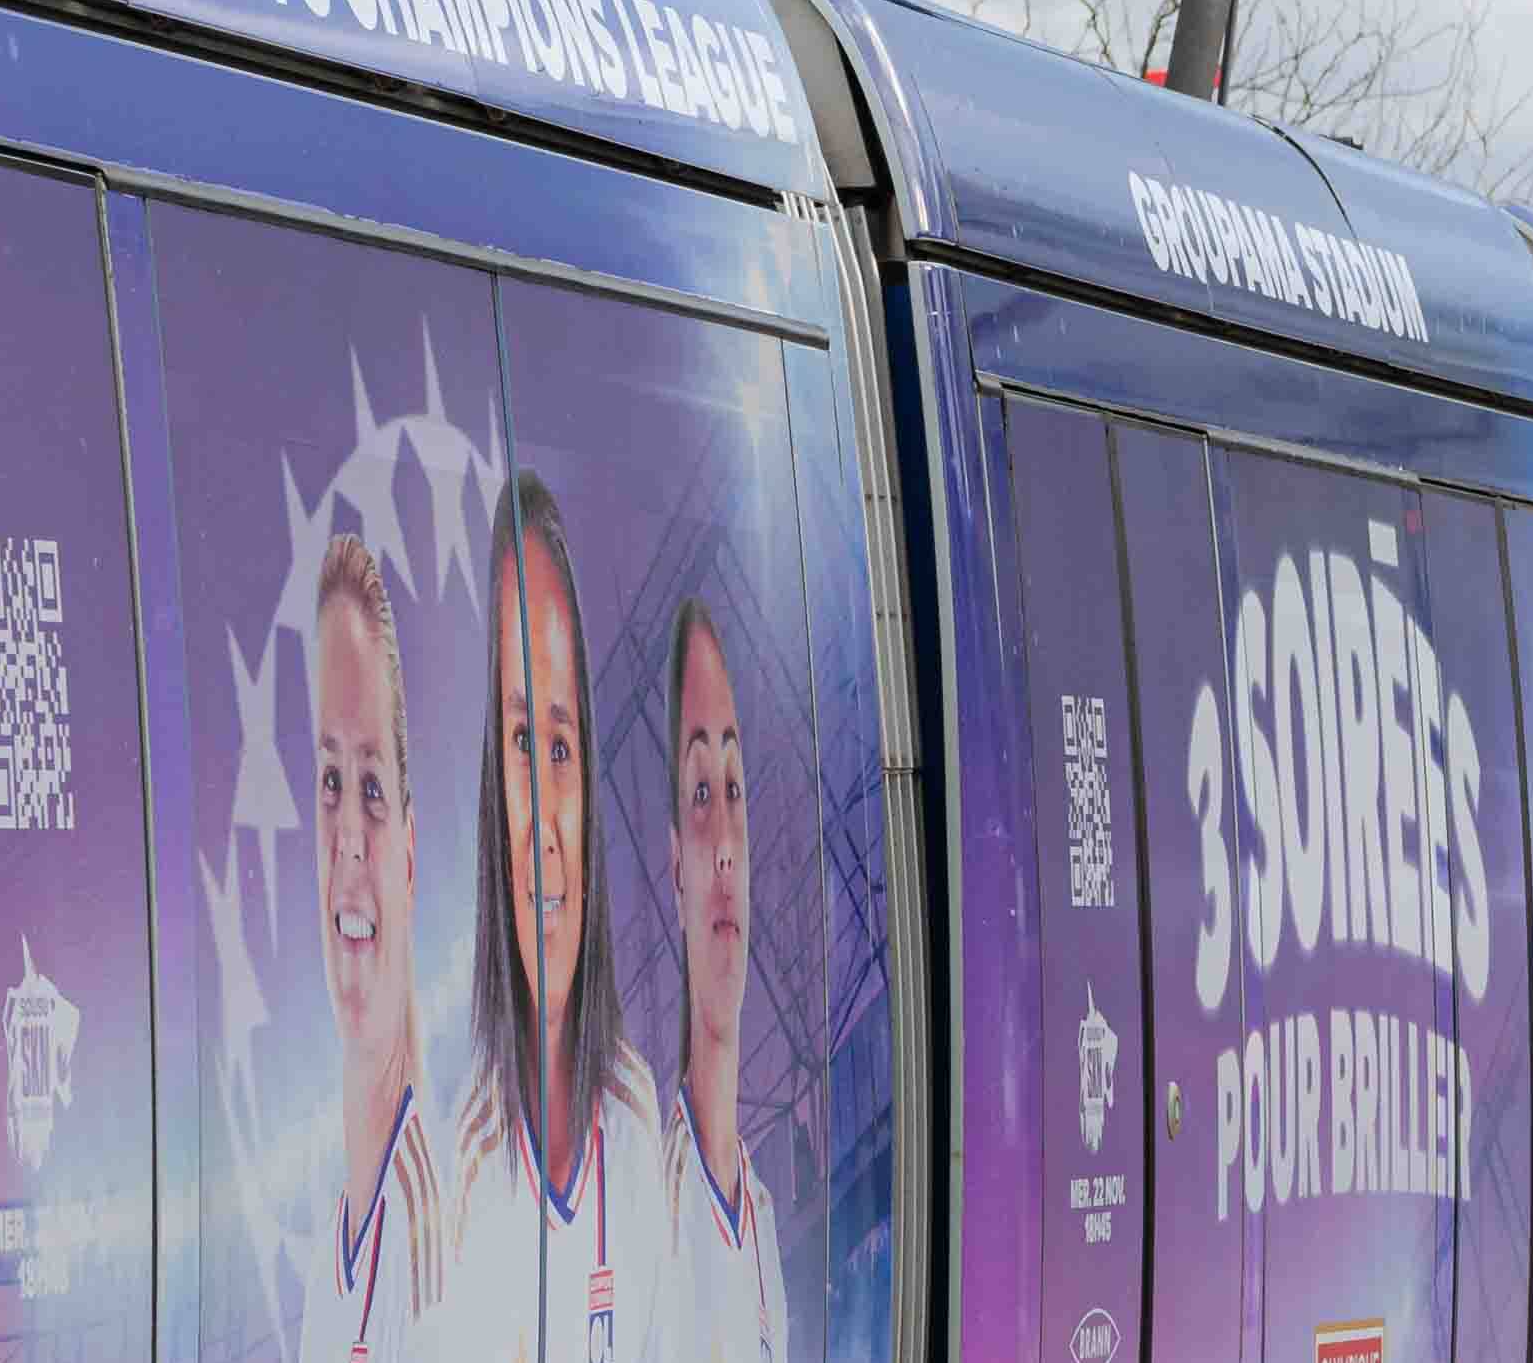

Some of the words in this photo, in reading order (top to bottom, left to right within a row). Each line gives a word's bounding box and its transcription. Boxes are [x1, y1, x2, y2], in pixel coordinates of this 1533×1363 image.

[1129, 170, 1313, 310] GROUPAMA
[1295, 221, 1429, 343] STADIUM
[1188, 683, 1232, 1011] 3
[1239, 518, 1490, 1006] SOIRÉES
[1216, 1012, 1321, 1220] POUR
[1329, 1008, 1472, 1201] BRILLER
[1079, 1325, 1112, 1359] BRANN
